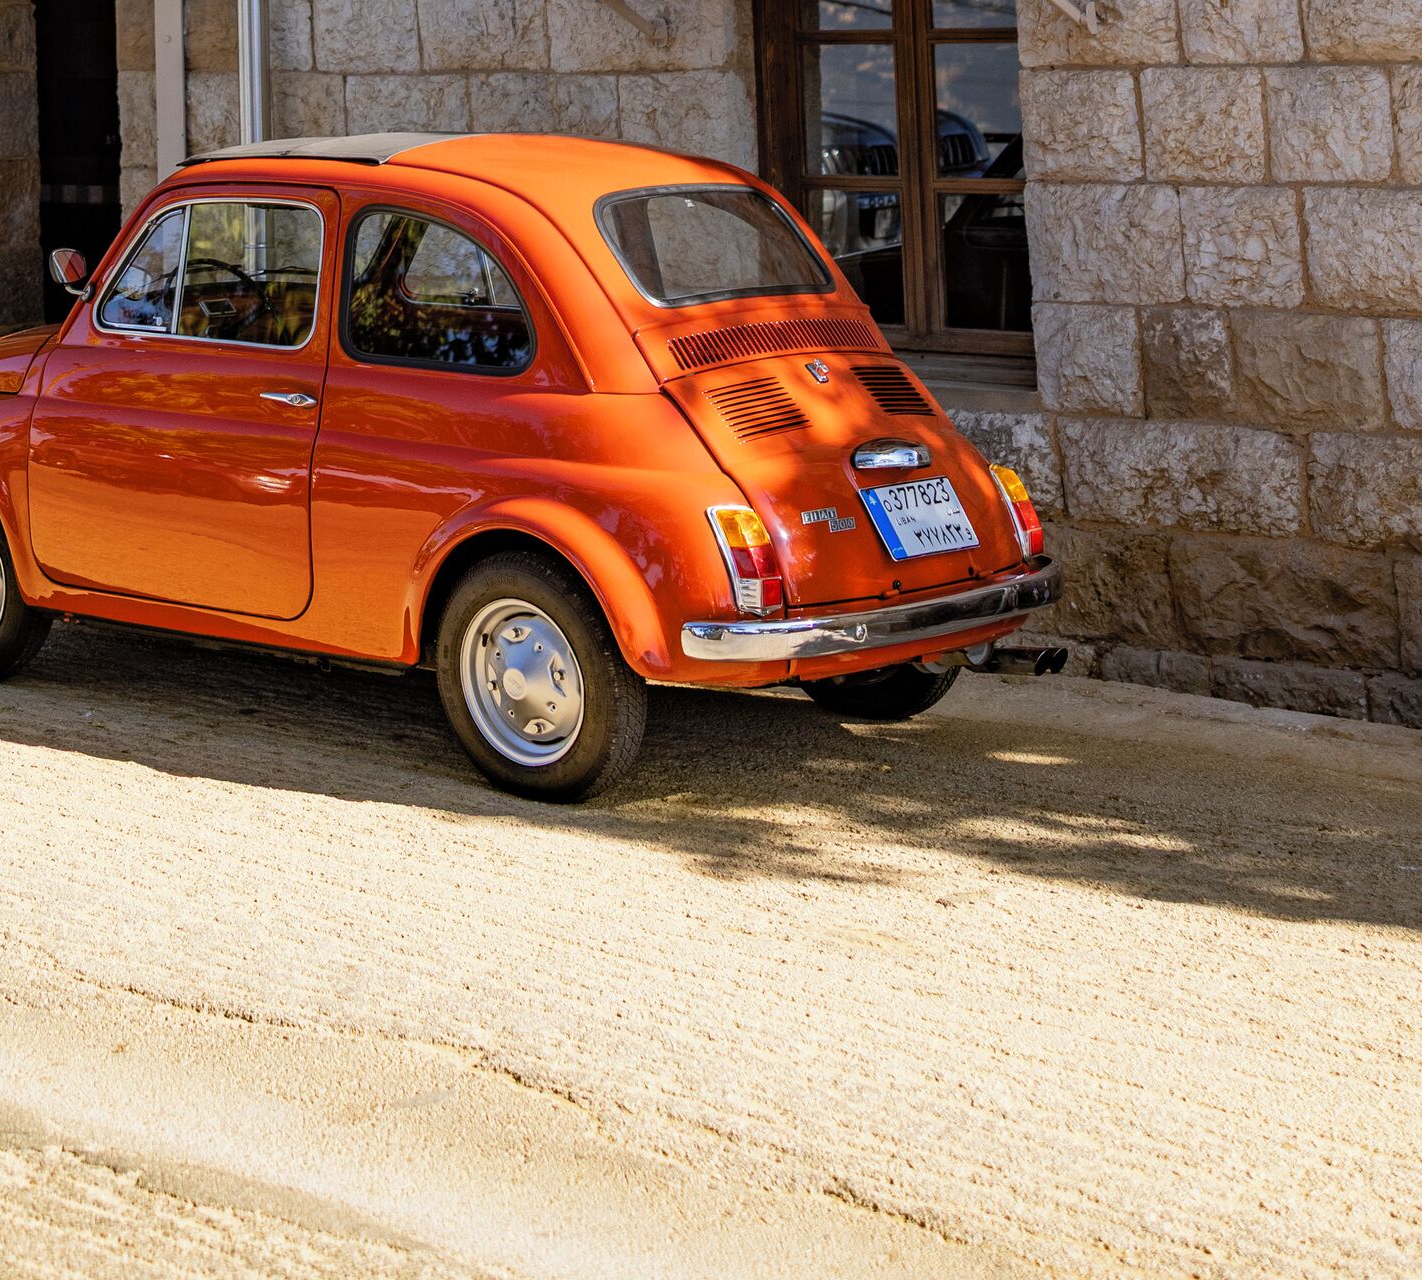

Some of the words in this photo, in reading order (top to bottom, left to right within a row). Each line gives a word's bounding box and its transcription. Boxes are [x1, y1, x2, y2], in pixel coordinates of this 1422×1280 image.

[802, 508, 837, 523] FIAT
[896, 516, 917, 526] LIBAN
[830, 517, 855, 531] 500
